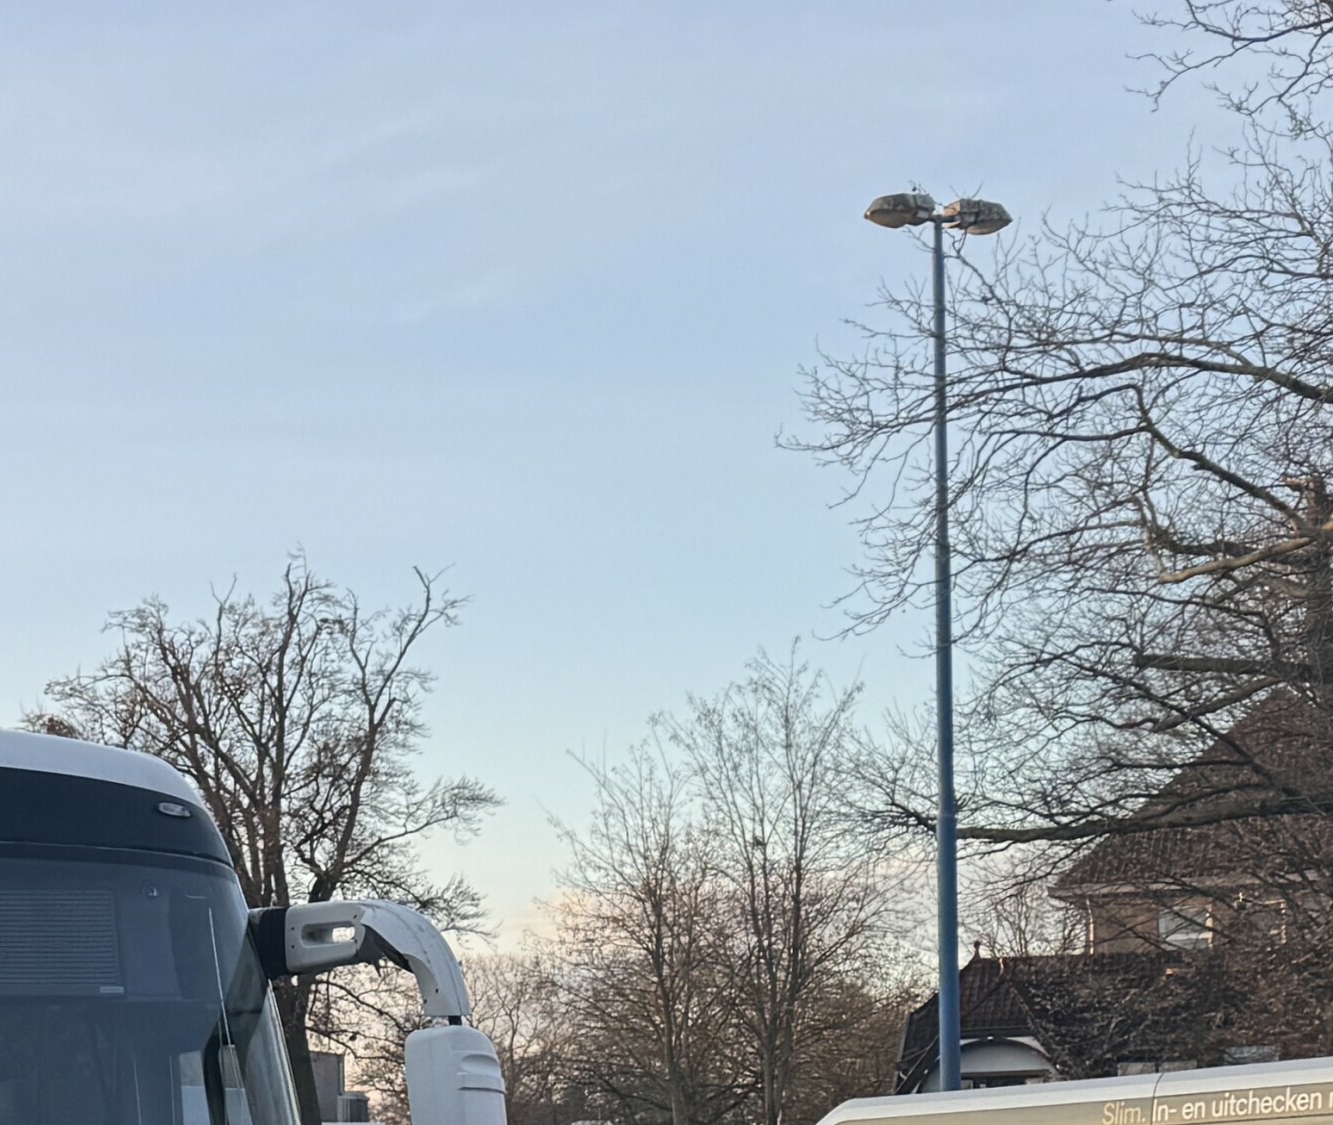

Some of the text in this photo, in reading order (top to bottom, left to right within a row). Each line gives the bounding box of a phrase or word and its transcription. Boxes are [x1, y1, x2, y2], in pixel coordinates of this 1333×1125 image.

[1102, 1102, 1146, 1125] Slim.
[1152, 1099, 1177, 1122] In-
[1182, 1100, 1206, 1120] en
[1211, 1087, 1322, 1117] uitchecken
